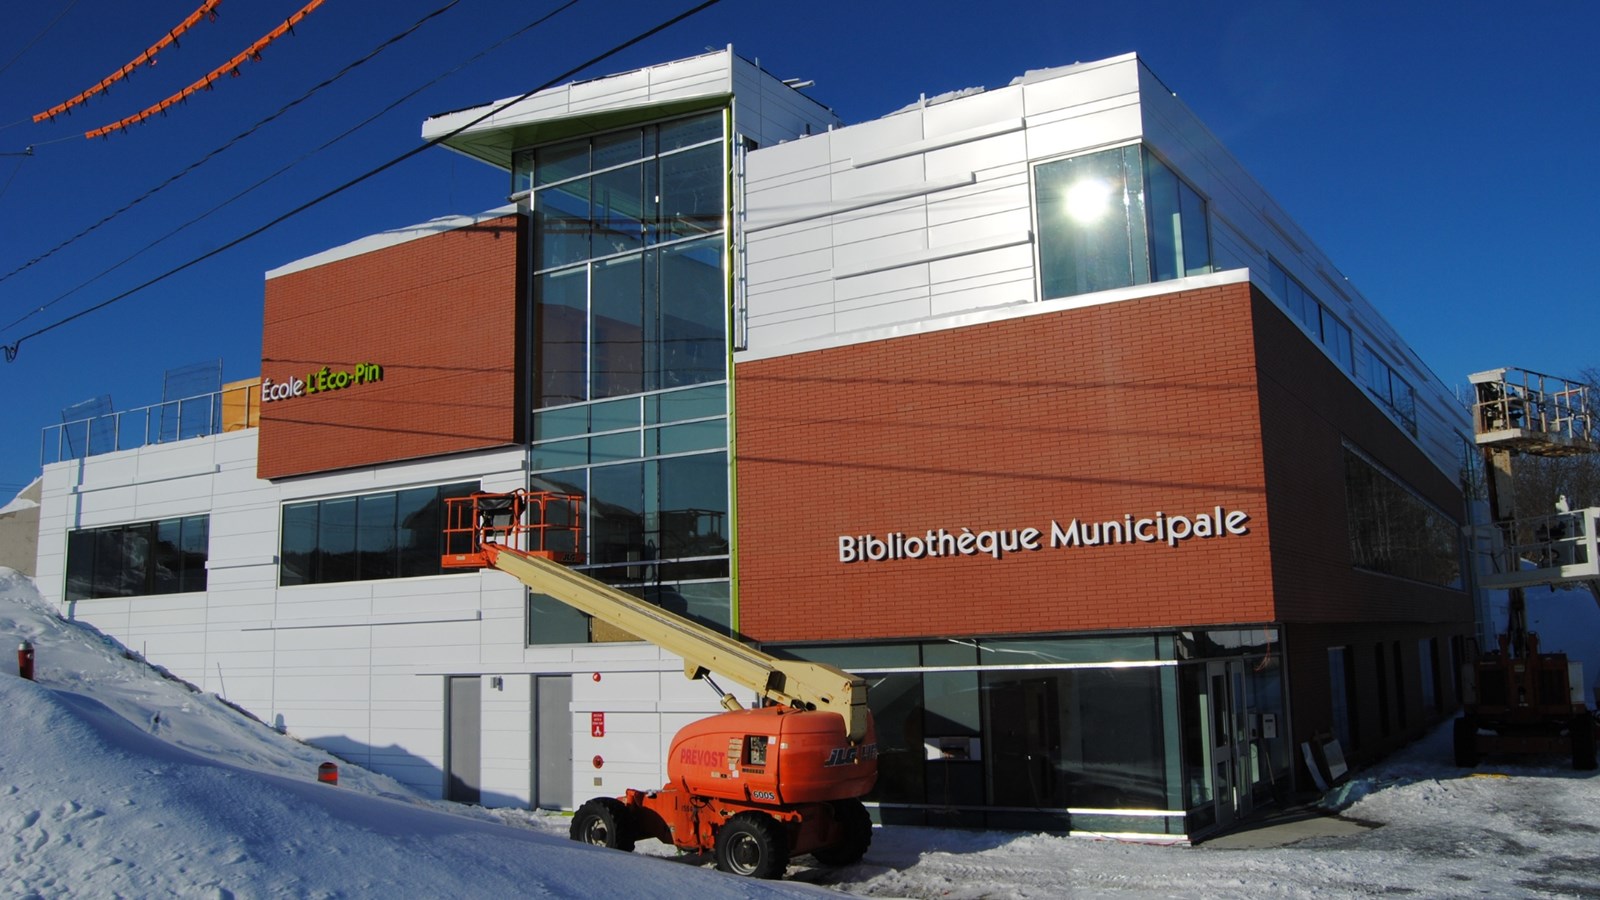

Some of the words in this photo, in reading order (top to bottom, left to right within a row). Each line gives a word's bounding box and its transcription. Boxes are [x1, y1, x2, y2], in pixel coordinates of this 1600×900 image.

[262, 376, 305, 402] École
[306, 362, 382, 393] L'Éco-Pin
[838, 527, 1041, 563] Bibliothèque
[1050, 505, 1249, 547] Municipale
[754, 791, 774, 800] 600S
